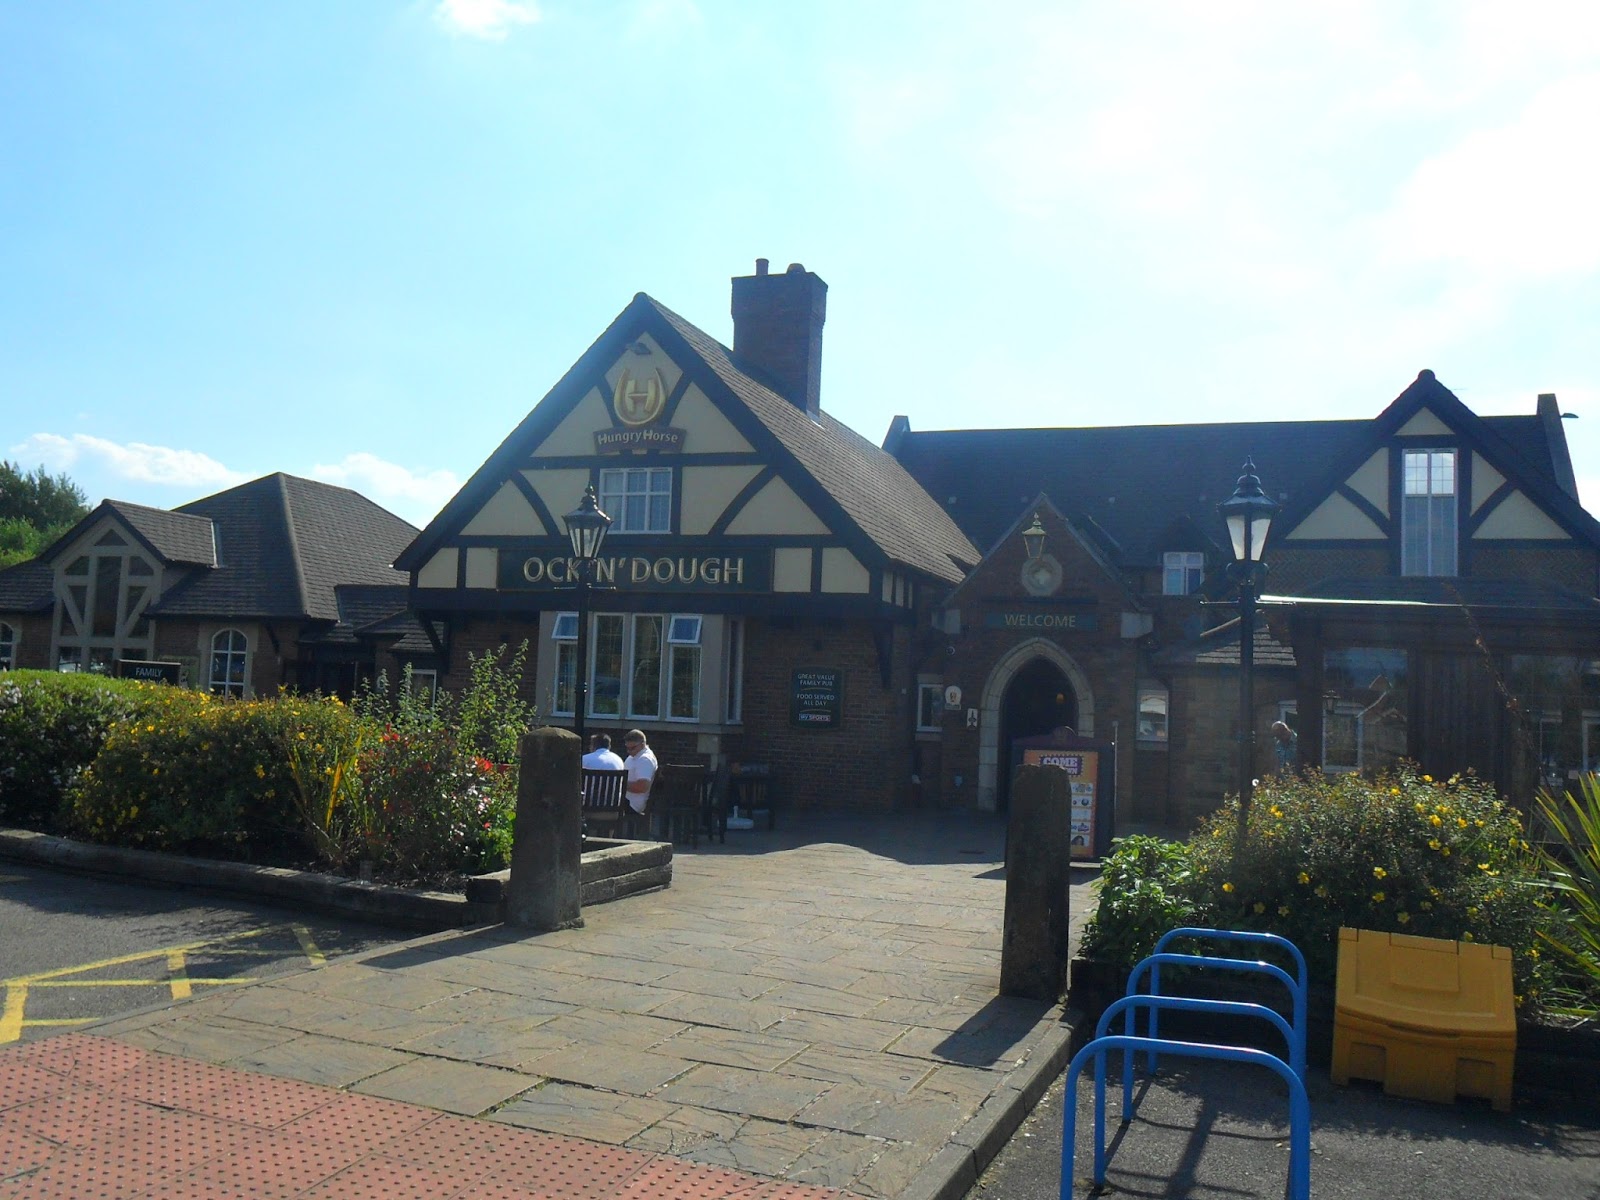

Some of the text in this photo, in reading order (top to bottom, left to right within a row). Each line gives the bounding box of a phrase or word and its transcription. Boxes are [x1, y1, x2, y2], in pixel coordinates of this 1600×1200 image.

[597, 429, 679, 445] Hungry Horse
[523, 557, 580, 582] OCK
[631, 557, 744, 584] DOUGH
[1005, 614, 1076, 628] WELCOME
[135, 667, 163, 677] FAMILY
[1042, 757, 1078, 768] COME
